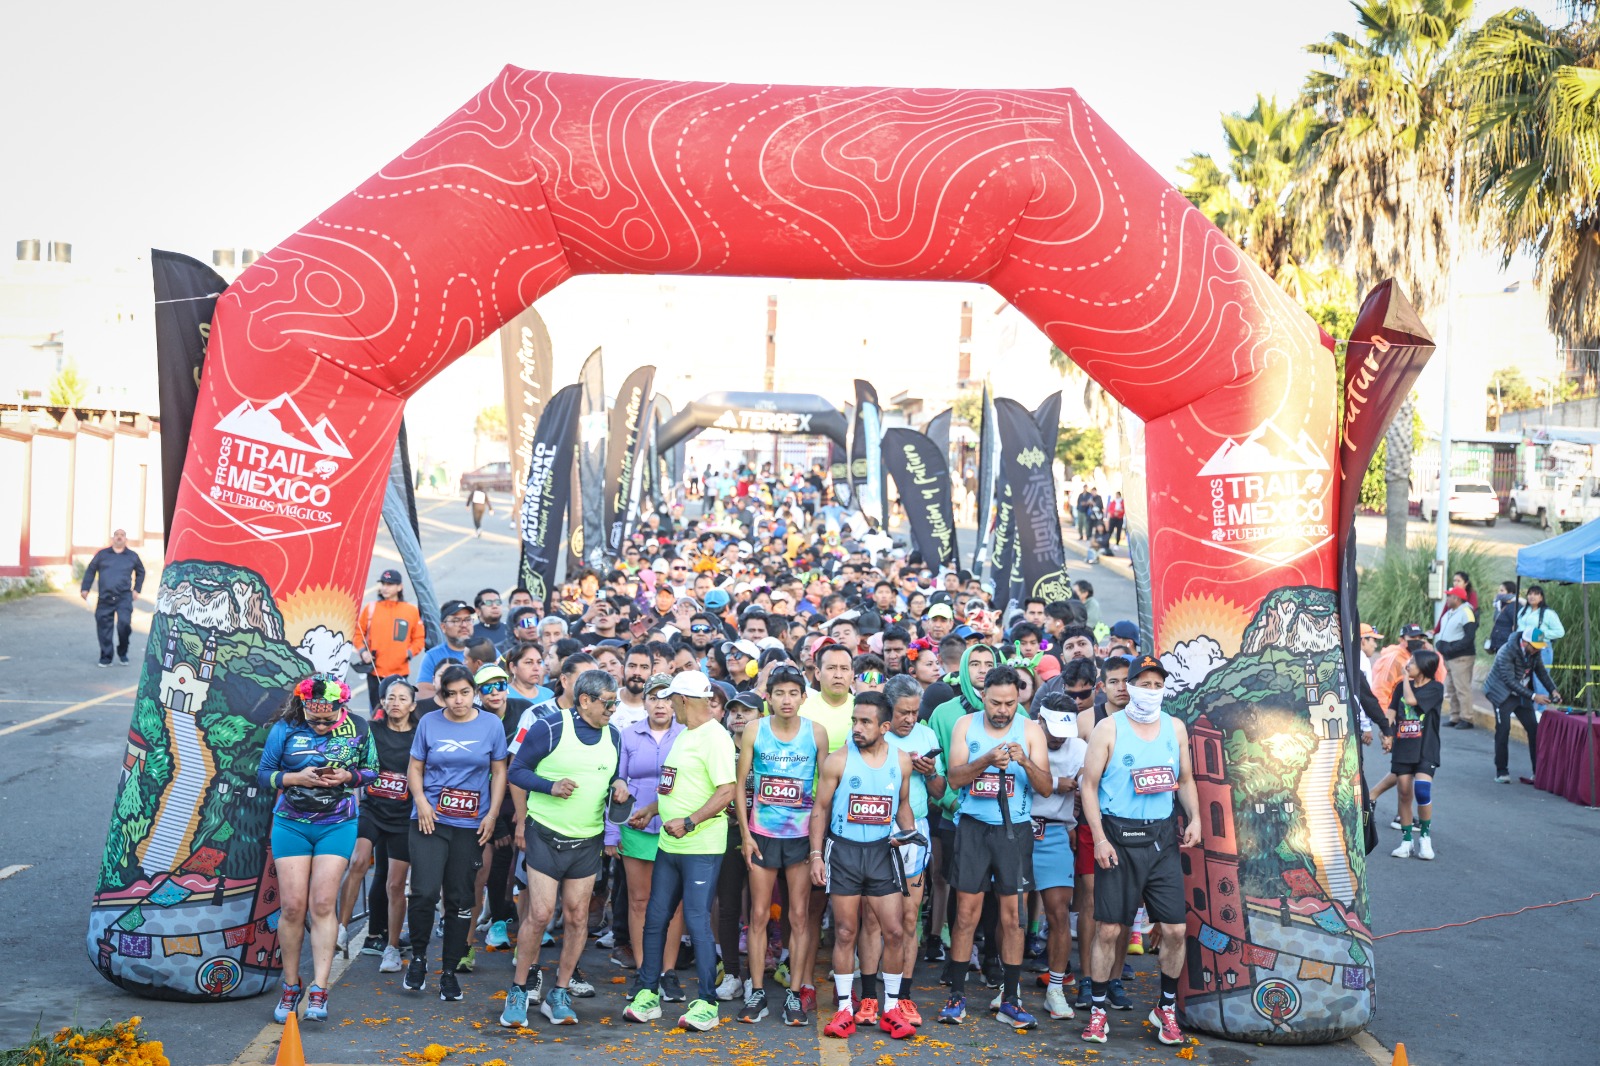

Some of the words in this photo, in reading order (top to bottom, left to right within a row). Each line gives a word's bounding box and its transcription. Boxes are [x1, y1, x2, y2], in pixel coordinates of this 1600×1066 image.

[738, 411, 813, 432] TERREX
[214, 436, 232, 485] FROGS
[234, 438, 314, 478] TRAIL
[227, 464, 331, 507] MÉXICO
[1225, 473, 1308, 499] TRAIL
[1210, 478, 1227, 527] FROGS
[760, 752, 810, 763] Boilermaker
[373, 778, 404, 792] 0342
[1138, 773, 1171, 787] 0632
[764, 785, 796, 798] 0340
[442, 796, 474, 809] 0214
[852, 803, 885, 815] 0604
